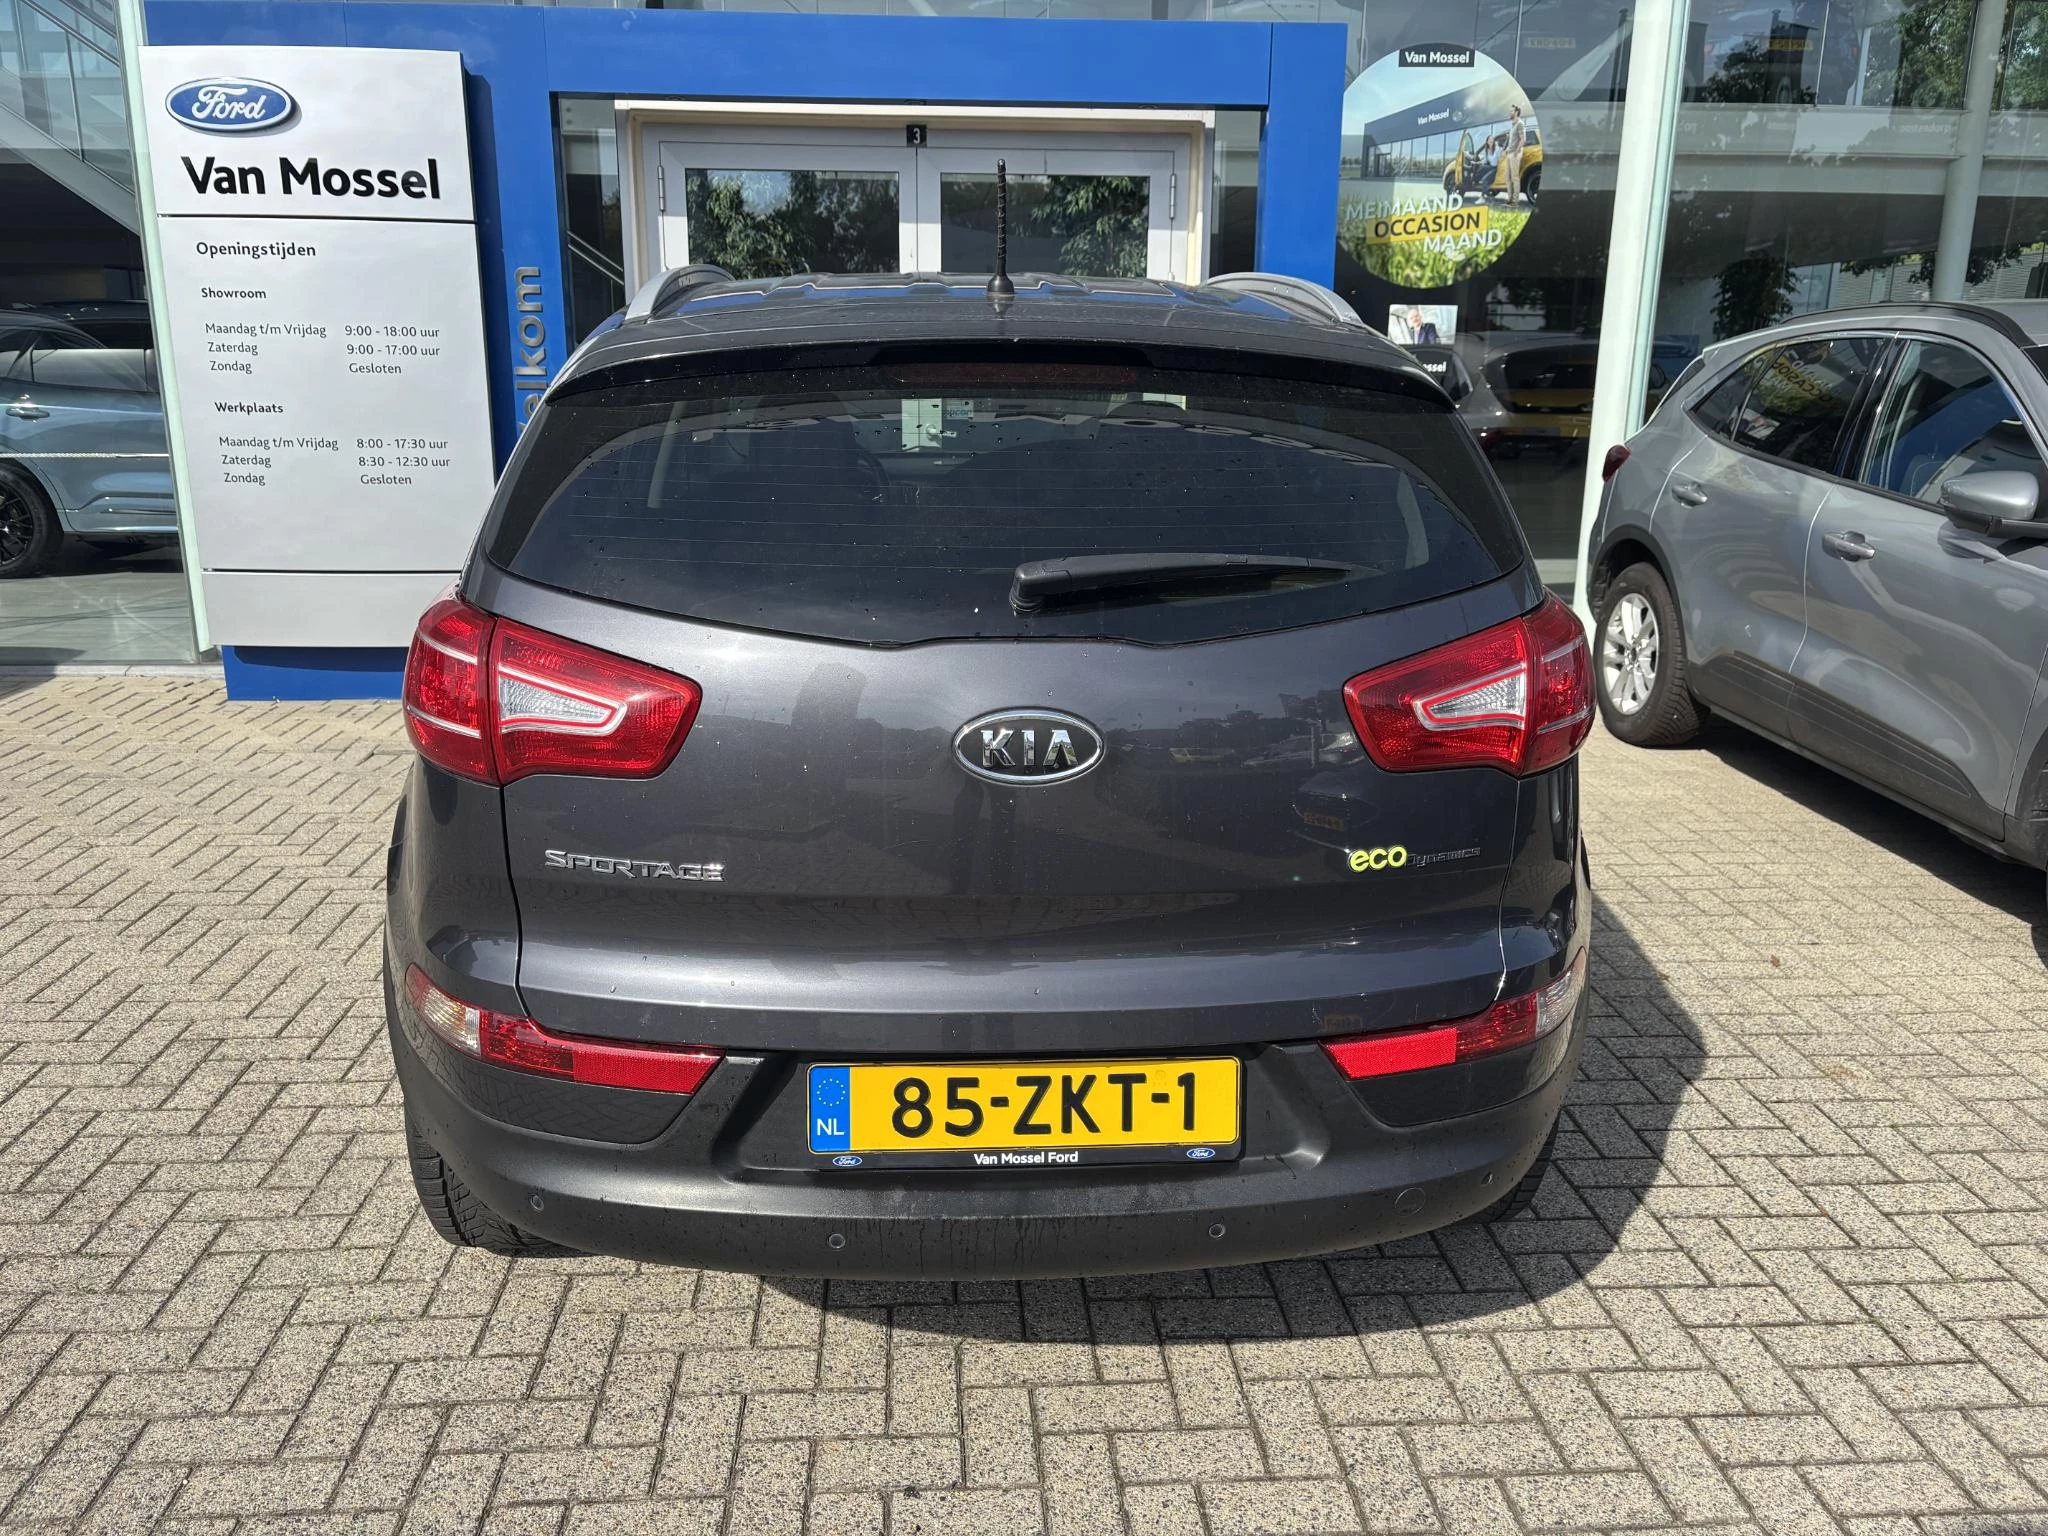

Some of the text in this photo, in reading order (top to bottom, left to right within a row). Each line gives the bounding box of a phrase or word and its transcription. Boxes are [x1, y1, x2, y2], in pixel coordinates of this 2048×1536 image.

[1405, 51, 1470, 63] Van Mossel
[191, 85, 266, 120] Ford
[913, 127, 921, 144] 3
[181, 156, 441, 199] Van Mossel
[1374, 211, 1480, 238] OCCASION
[1423, 229, 1502, 253] MAAND
[196, 241, 316, 260] Openingstijden
[201, 286, 267, 299] Showroom
[205, 322, 257, 337] Maandag
[260, 323, 281, 335] t/m
[284, 323, 327, 339] Vrijdag
[344, 325, 372, 336] 9:00
[384, 326, 417, 337] 18:00
[420, 329, 440, 338] uur
[208, 341, 258, 356] Zaterdag
[346, 343, 374, 355] 9:00
[385, 344, 418, 356] 17:00
[420, 347, 440, 356] uur
[209, 360, 402, 375] Zondag Gesloten
[214, 402, 284, 416] Werkplaats
[219, 437, 271, 451] Maandag
[272, 437, 294, 448] t/m
[296, 437, 339, 452] Vrijdag
[356, 438, 384, 449] 8:00
[394, 438, 426, 450] 17:30
[428, 440, 449, 449] uur
[221, 454, 272, 469] Zaterdag
[358, 456, 385, 467] 8:30
[395, 456, 428, 467] 12:30
[431, 459, 451, 467] uur
[223, 472, 413, 487] Zondag Gesloten
[980, 729, 1078, 767] KIA
[544, 849, 724, 882] SPORTAGE
[891, 1071, 1196, 1139] 85-ZKT-1
[816, 1118, 844, 1136] NL
[973, 1150, 1079, 1165] Van Mossel Ford
